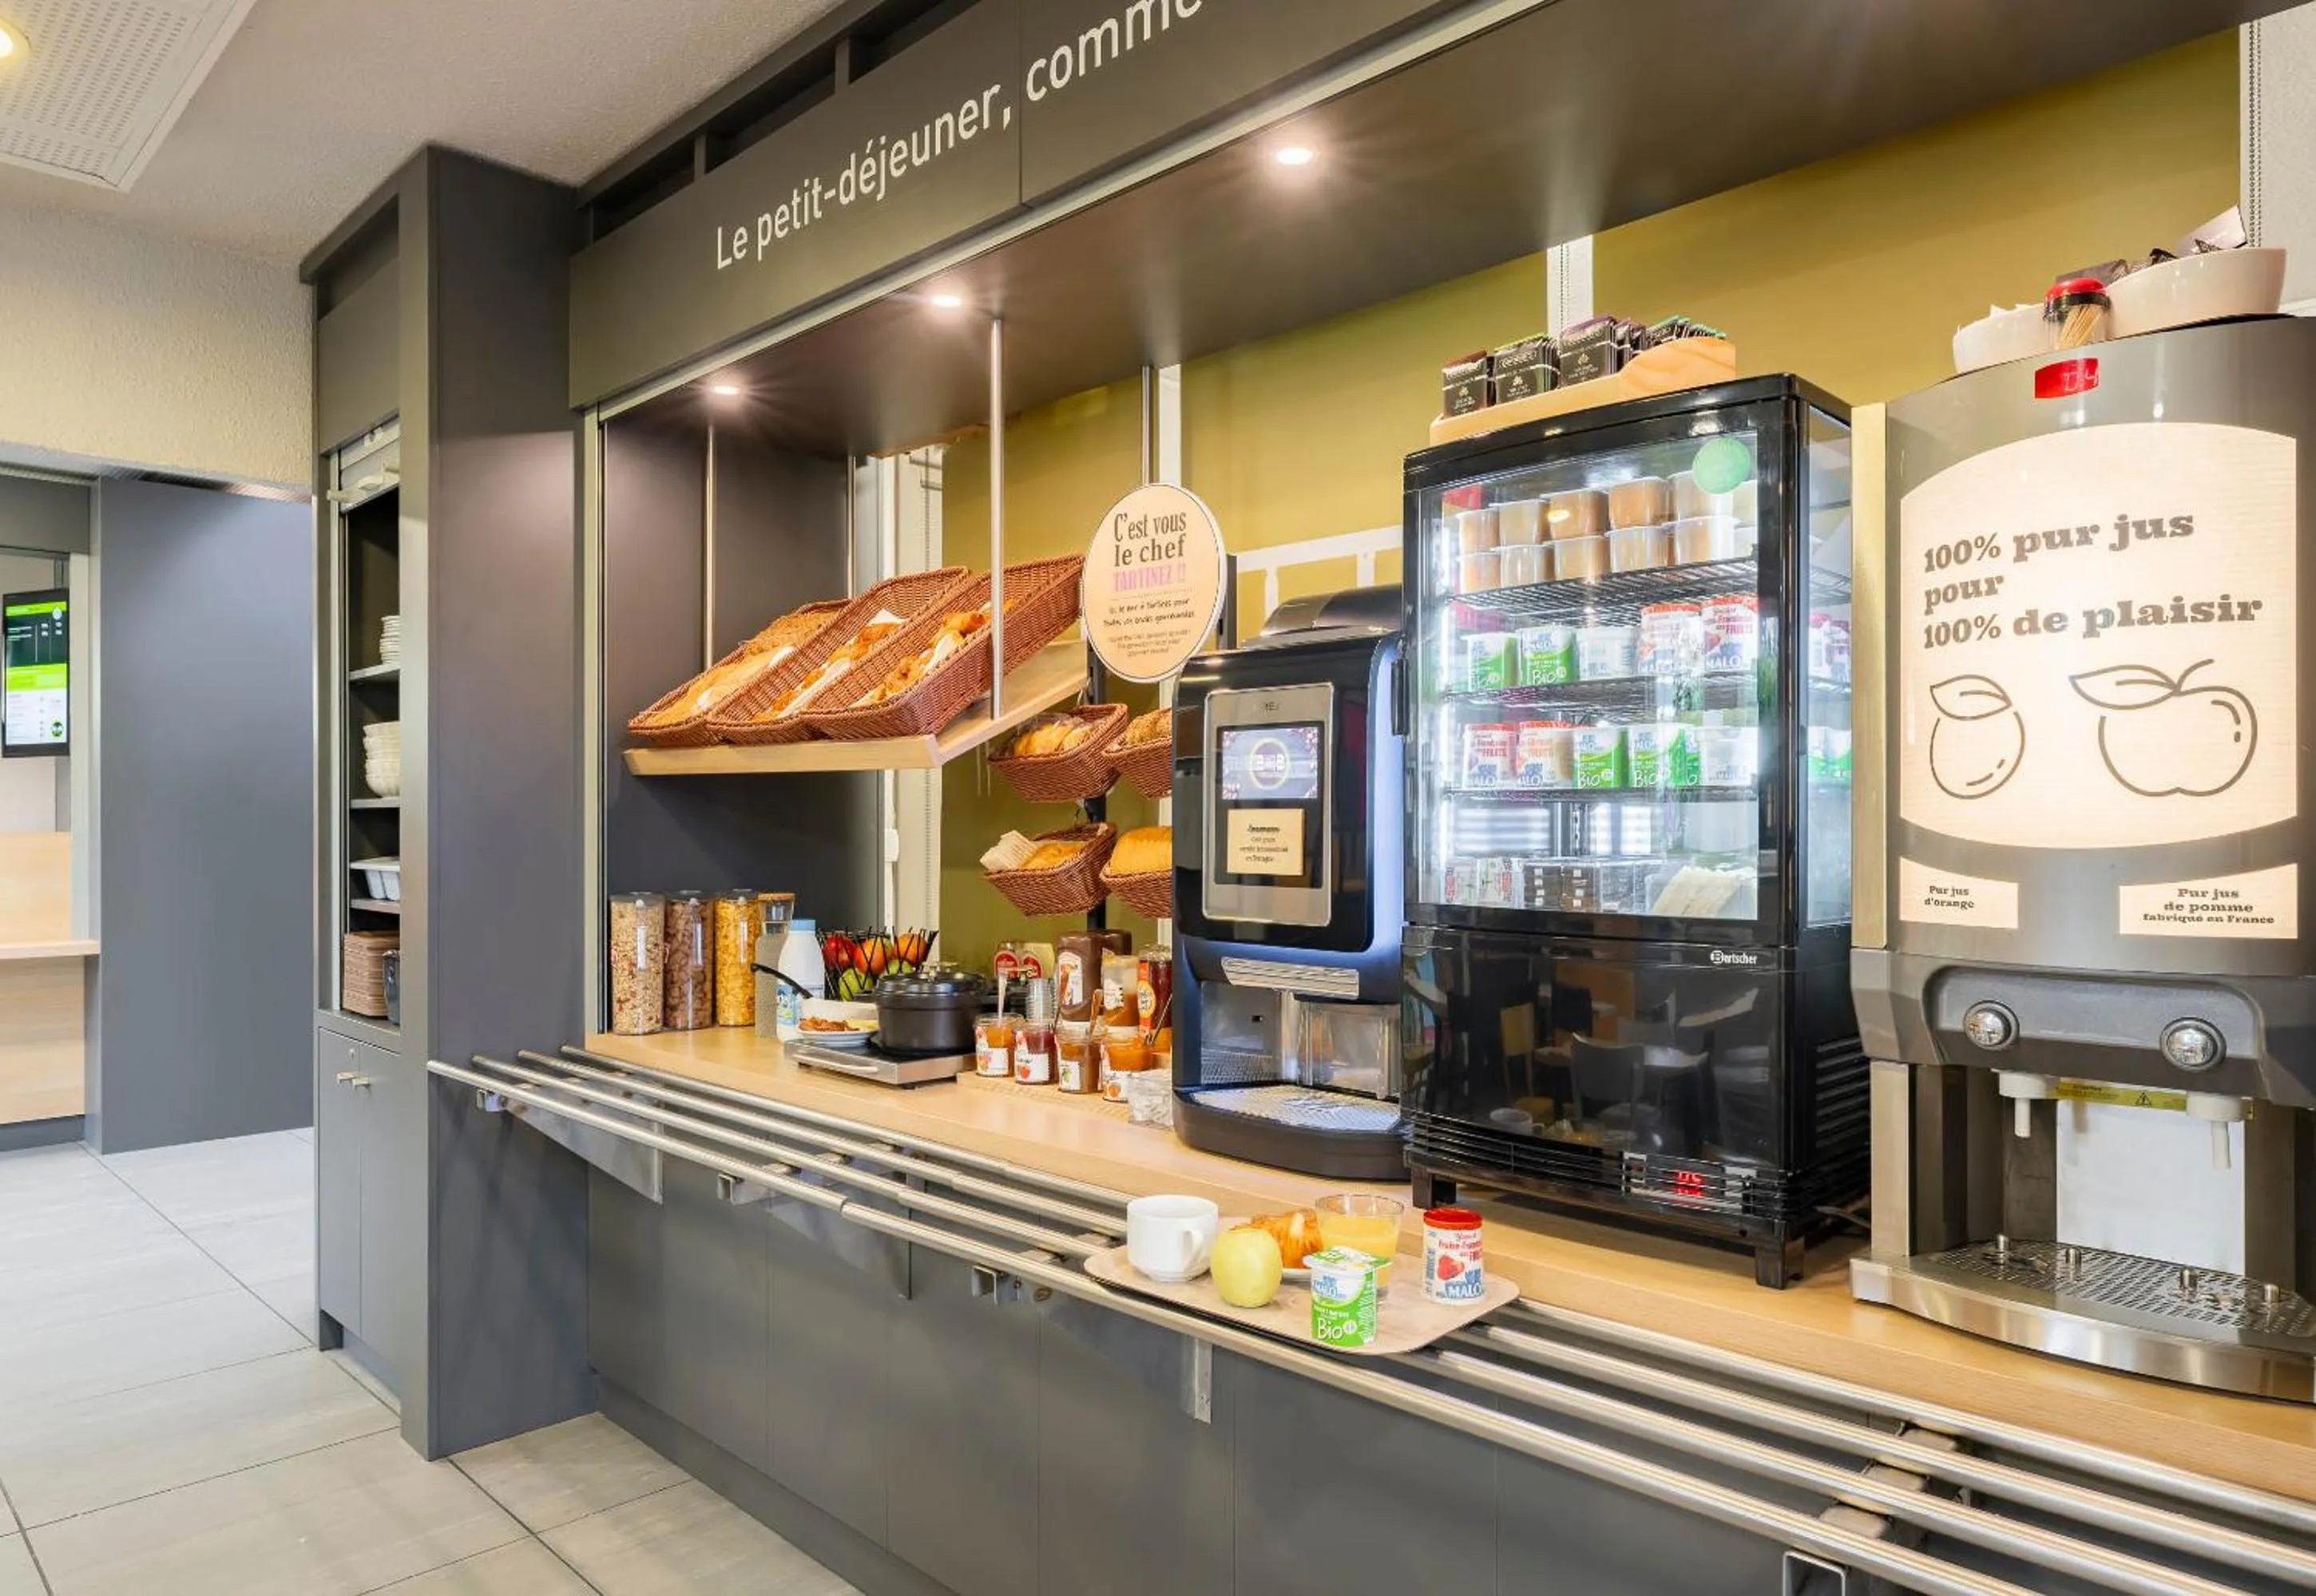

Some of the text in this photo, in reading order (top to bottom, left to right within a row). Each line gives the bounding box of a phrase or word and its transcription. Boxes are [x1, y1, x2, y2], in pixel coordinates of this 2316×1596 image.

[716, 224, 748, 270] Le
[756, 83, 1013, 261] petit-déjeuner,
[1113, 512, 1188, 542] C'est vous
[1114, 533, 1187, 568] le chef
[1924, 513, 2195, 573] 100% pur jus
[1113, 565, 1172, 592] TARTINEZ
[1924, 575, 2005, 616] pour
[1924, 593, 2263, 649] 100% de plaisir
[1532, 669, 1557, 685] Bio
[1924, 897, 1974, 910] d'orange
[1929, 885, 1969, 897] Pur jus
[2177, 888, 2239, 901] Pur jus
[2163, 901, 2255, 914] de pomme
[2227, 915, 2275, 925] France
[1317, 1317, 1344, 1340] Bio
